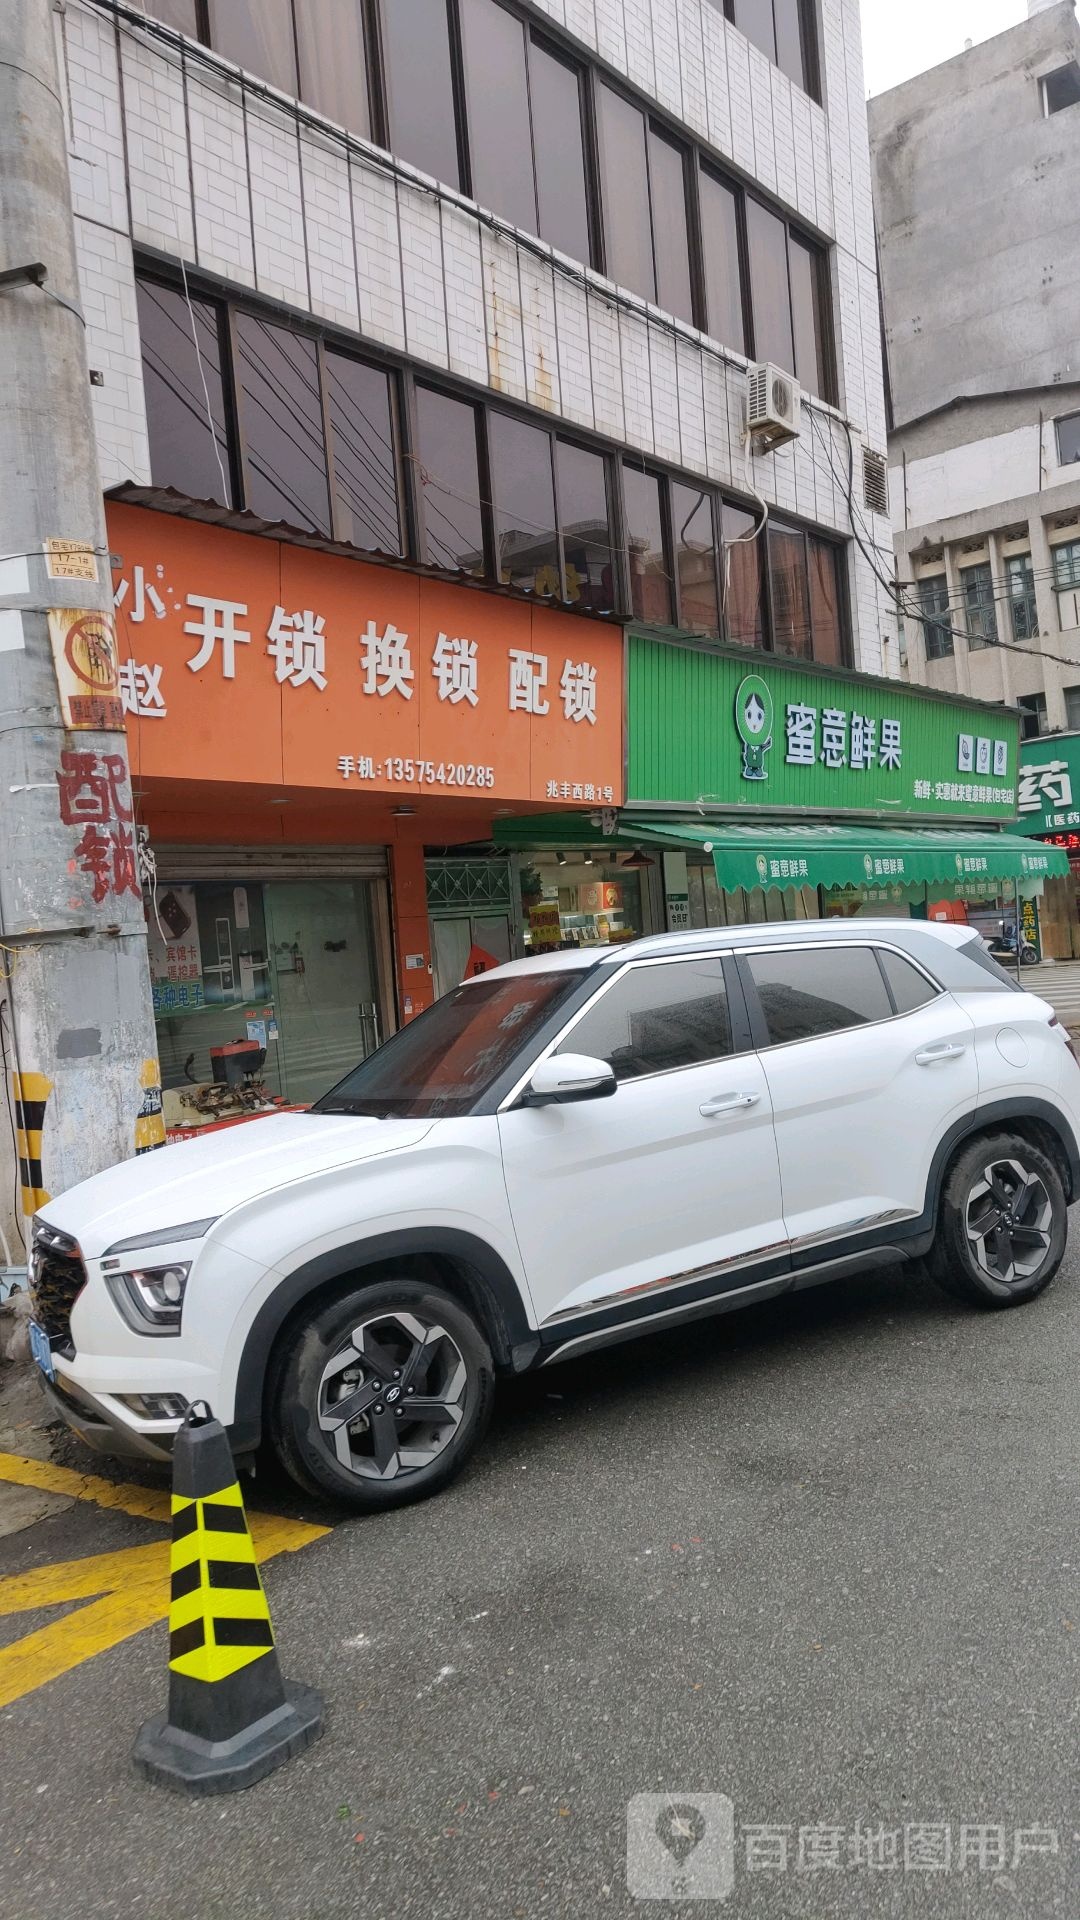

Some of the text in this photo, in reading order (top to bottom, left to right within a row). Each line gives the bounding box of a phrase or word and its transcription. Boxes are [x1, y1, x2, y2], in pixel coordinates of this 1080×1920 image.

[57, 554, 89, 565] 17-1#
[183, 593, 598, 725] 开锁 换锁 配锁
[784, 701, 903, 770] 蜜意鲜果
[546, 779, 614, 803] 兆丰西路1号
[1018, 760, 1073, 812] 药
[56, 749, 142, 904] 配锁
[166, 944, 197, 962] 宾馆卡
